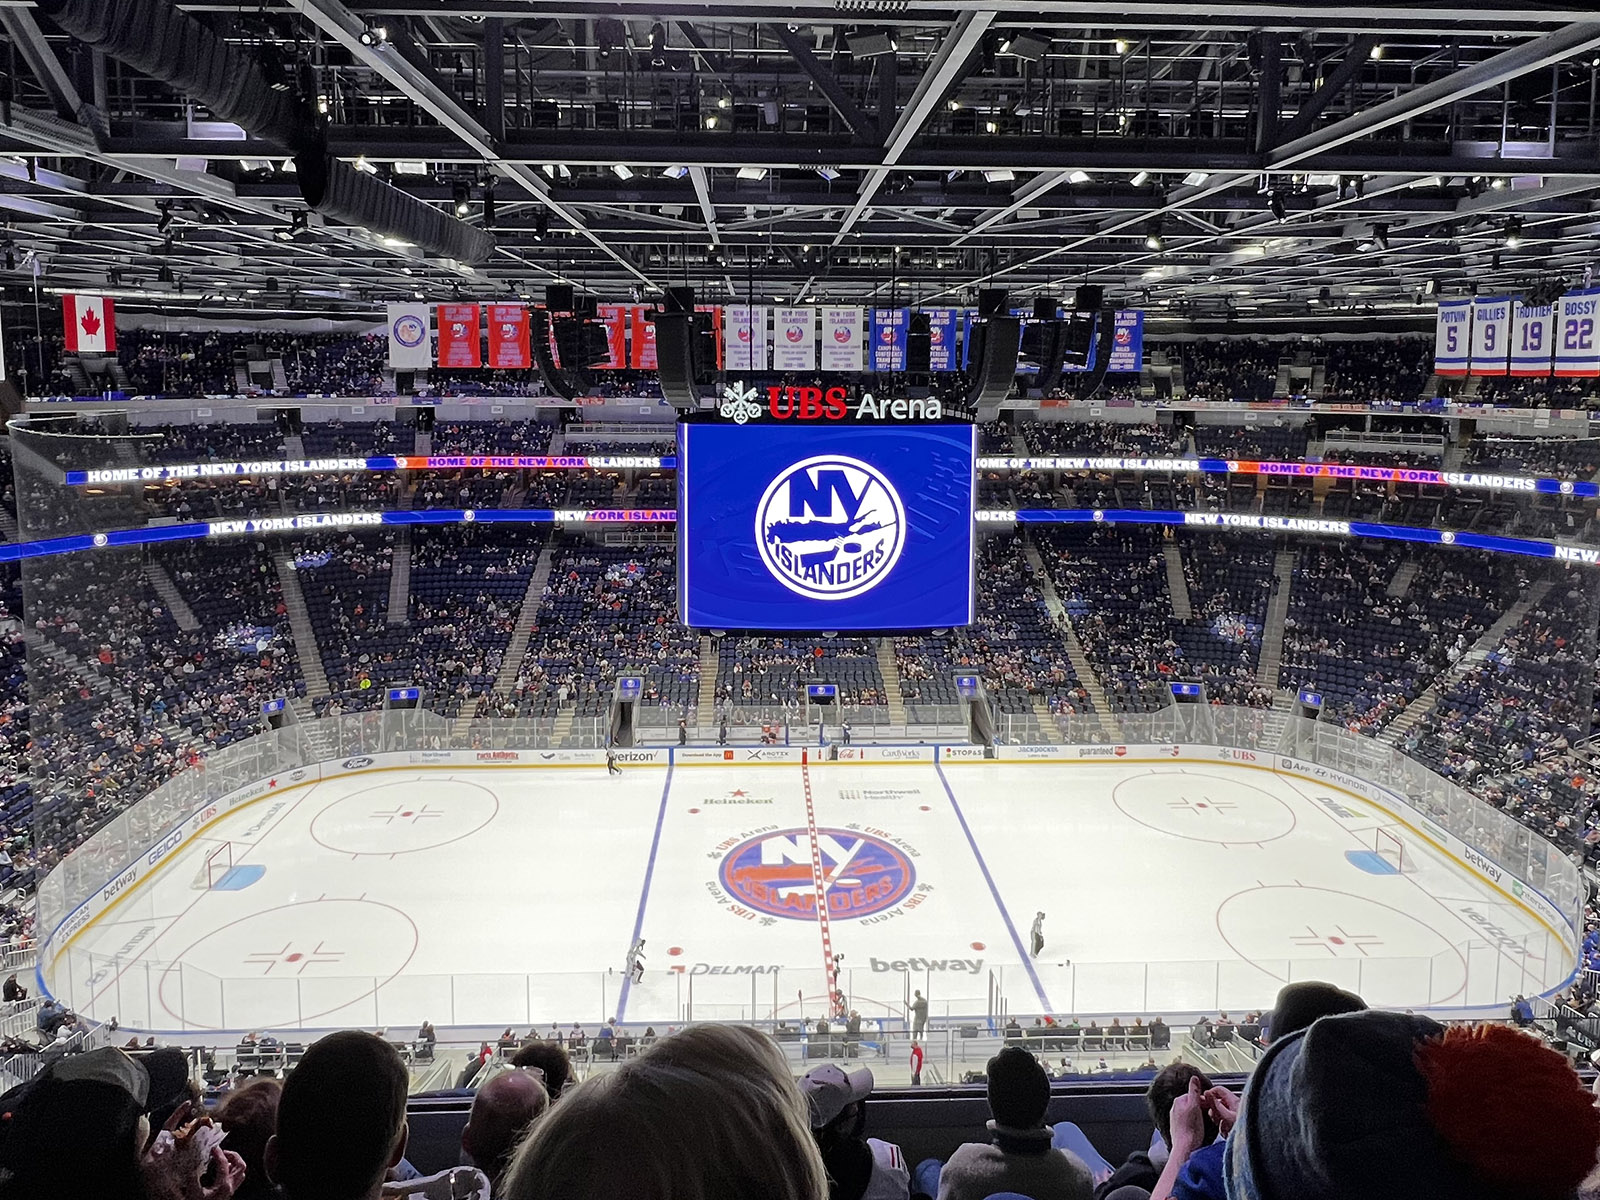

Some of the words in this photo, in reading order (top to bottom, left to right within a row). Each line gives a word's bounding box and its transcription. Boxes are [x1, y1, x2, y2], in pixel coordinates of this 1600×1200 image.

[1440, 310, 1466, 323] POTVIN
[1476, 307, 1506, 322] GILLIES
[1564, 300, 1597, 317] BOSSY
[1446, 325, 1458, 352] 5
[1484, 324, 1496, 351] 9
[1521, 321, 1543, 351] 19
[1564, 318, 1594, 350] 22
[766, 386, 848, 420] UBS
[855, 393, 942, 420] Arena
[87, 468, 140, 485] HOME
[142, 467, 166, 480] OF
[168, 464, 199, 479] THE
[200, 462, 240, 477] NEW
[241, 460, 284, 475] YORK
[284, 457, 367, 473] ISLANDERS
[428, 457, 467, 467] HOME
[470, 457, 488, 467] OF
[491, 457, 517, 467] THE
[518, 457, 549, 467] NEW
[551, 457, 585, 467] YORK
[587, 456, 661, 468] ISLANDERS
[1010, 458, 1027, 470] OF
[1028, 458, 1054, 470] THE
[1055, 458, 1087, 470] NEW
[1088, 458, 1122, 470] YORK
[1123, 458, 1200, 471] ISLANDERS
[1259, 462, 1301, 474] HOME
[1304, 464, 1323, 475] OF
[1327, 465, 1357, 477] THE
[1359, 467, 1397, 479] NEW
[1399, 469, 1441, 482] YORK
[1443, 472, 1536, 490] ISLANDERS
[789, 469, 876, 524] NY
[209, 518, 250, 535] NEW
[251, 516, 296, 531] YORK
[296, 512, 383, 529] ISLANDERS
[554, 510, 590, 521] NEW
[590, 510, 625, 520] YORK
[628, 510, 677, 520] ISLAND
[975, 510, 1016, 521] NDERS
[1184, 513, 1220, 525] NEW
[1221, 514, 1261, 527] YORK
[1263, 516, 1350, 533] ISLANDERS
[774, 538, 885, 586] ISLANDERS
[1553, 545, 1599, 562] NEW
[613, 751, 654, 761] verizon
[1079, 747, 1113, 758] guaranteed
[1232, 750, 1257, 762] UBS
[1329, 773, 1368, 794] HYUNDAI
[229, 786, 264, 806] Heineken
[200, 807, 217, 823] UBS
[149, 830, 182, 866] GEICO
[716, 836, 740, 851] UBS
[740, 824, 779, 839] Arena
[864, 826, 892, 841] UBS
[890, 837, 922, 858] Arena
[1464, 847, 1502, 883] betway
[103, 867, 138, 902] betway
[705, 880, 732, 906] Arena
[741, 876, 893, 911] ISLANDERS
[725, 904, 757, 921] UBS
[903, 893, 929, 910] UBS
[58, 903, 90, 937] AMERICAN
[60, 912, 91, 944] EXPRESS
[859, 909, 905, 927] Arena
[1460, 906, 1528, 955] verizon
[690, 962, 781, 976] DELMAR
[870, 957, 985, 975] betway
